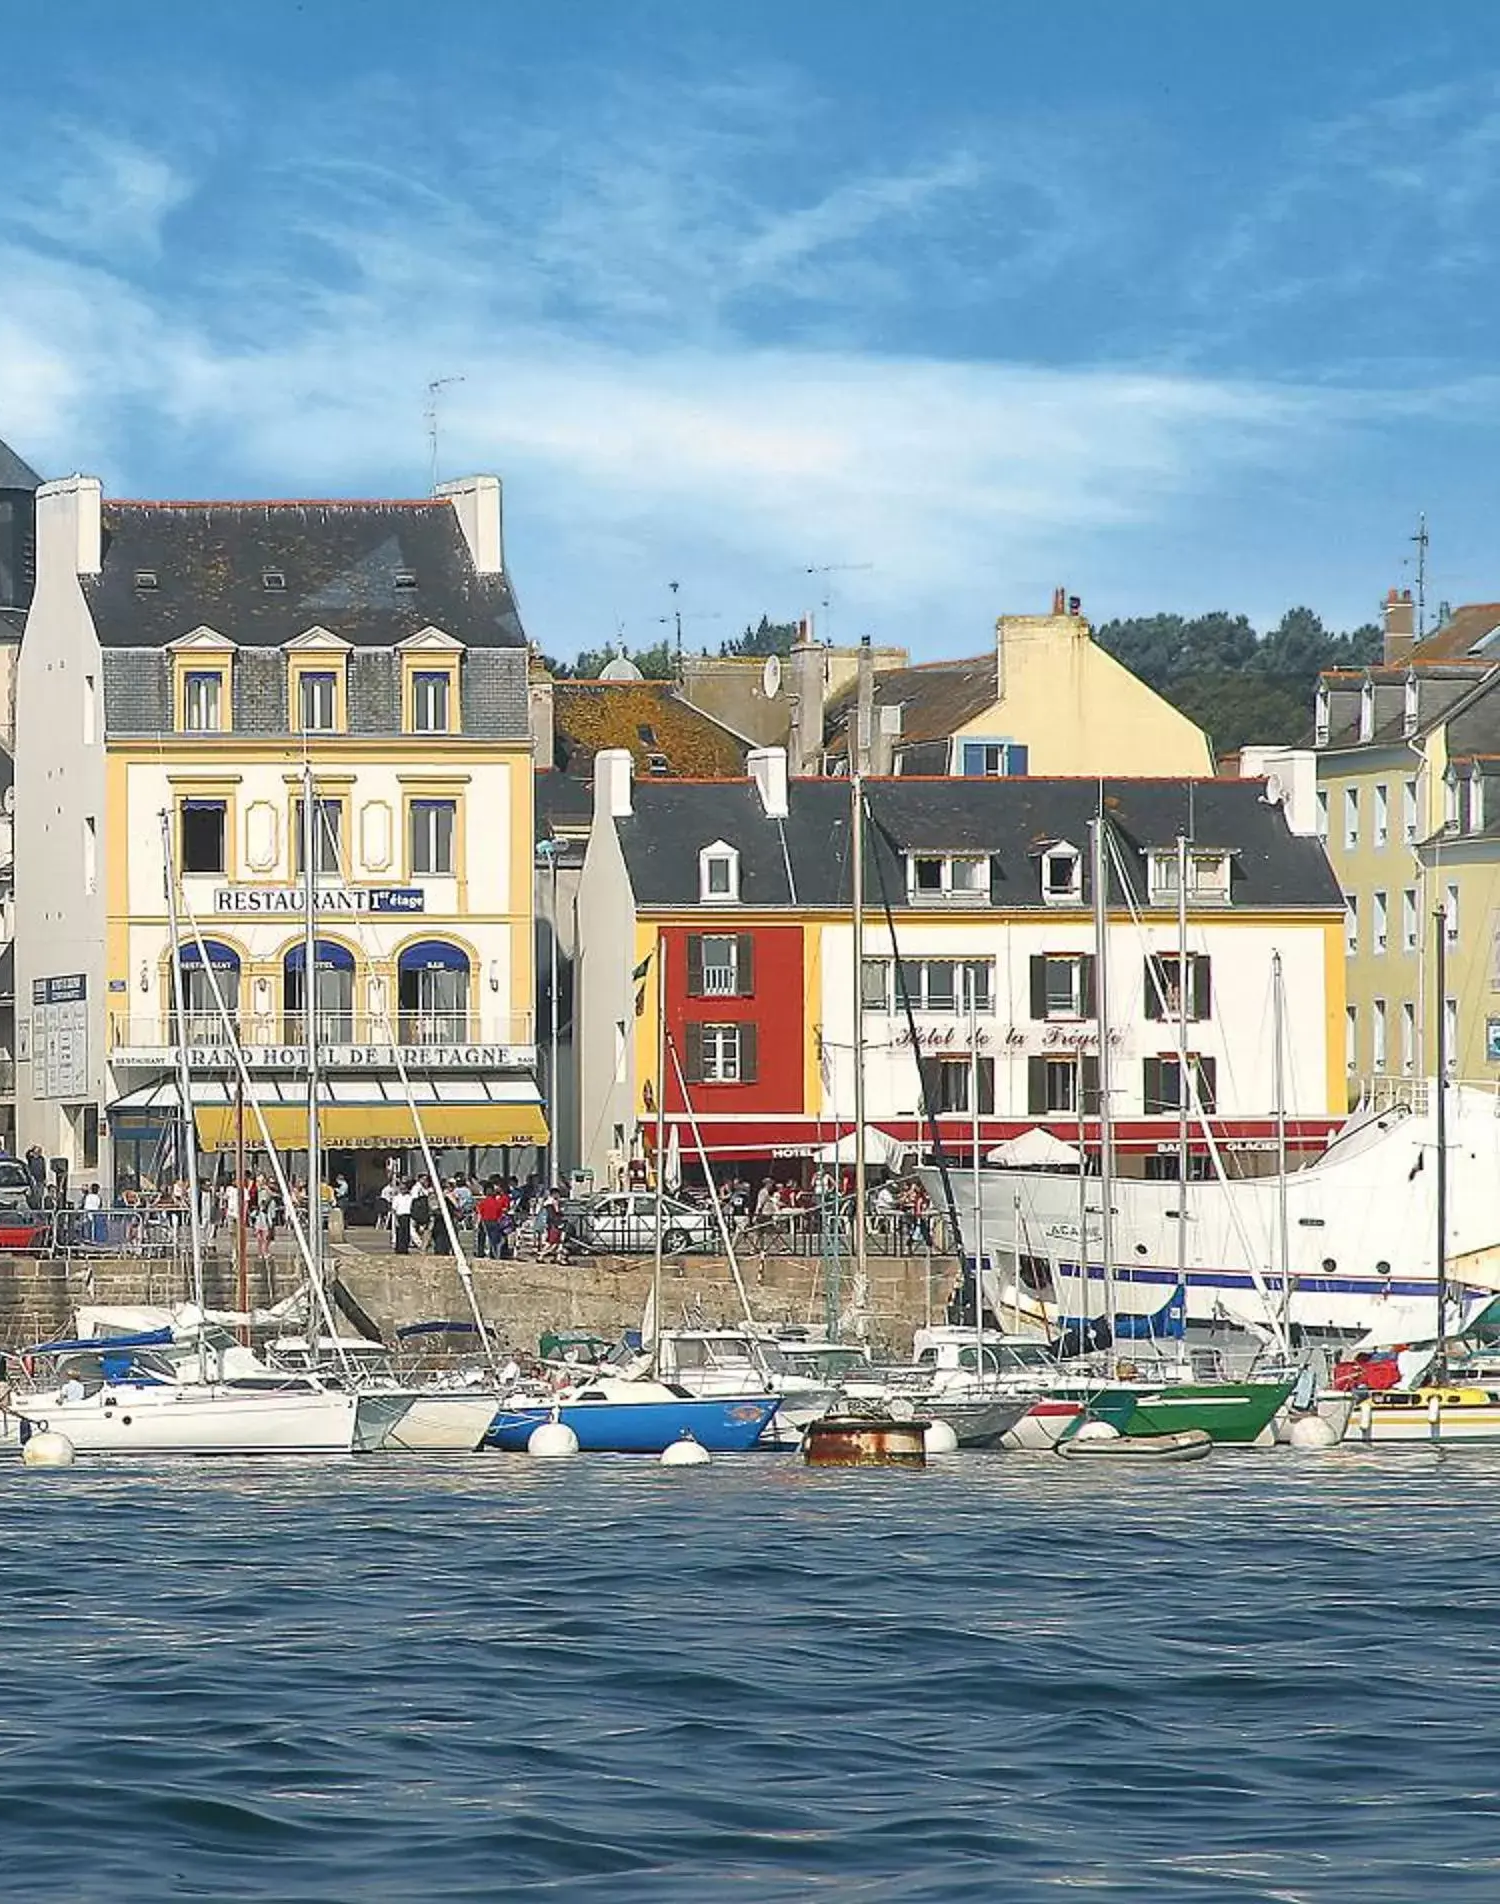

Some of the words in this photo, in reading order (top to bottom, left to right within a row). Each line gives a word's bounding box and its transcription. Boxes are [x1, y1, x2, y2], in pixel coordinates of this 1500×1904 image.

[218, 891, 366, 911] RESTAURANT
[389, 892, 423, 909] étage
[180, 961, 231, 969] RESTARANT
[427, 961, 445, 969] BAR
[966, 1026, 991, 1046] de
[1005, 1027, 1028, 1046] la
[263, 1048, 341, 1065] HOTEL
[349, 1048, 378, 1065] DE
[388, 1047, 511, 1065] BRETAGNE
[771, 1147, 815, 1159] HOTEL
